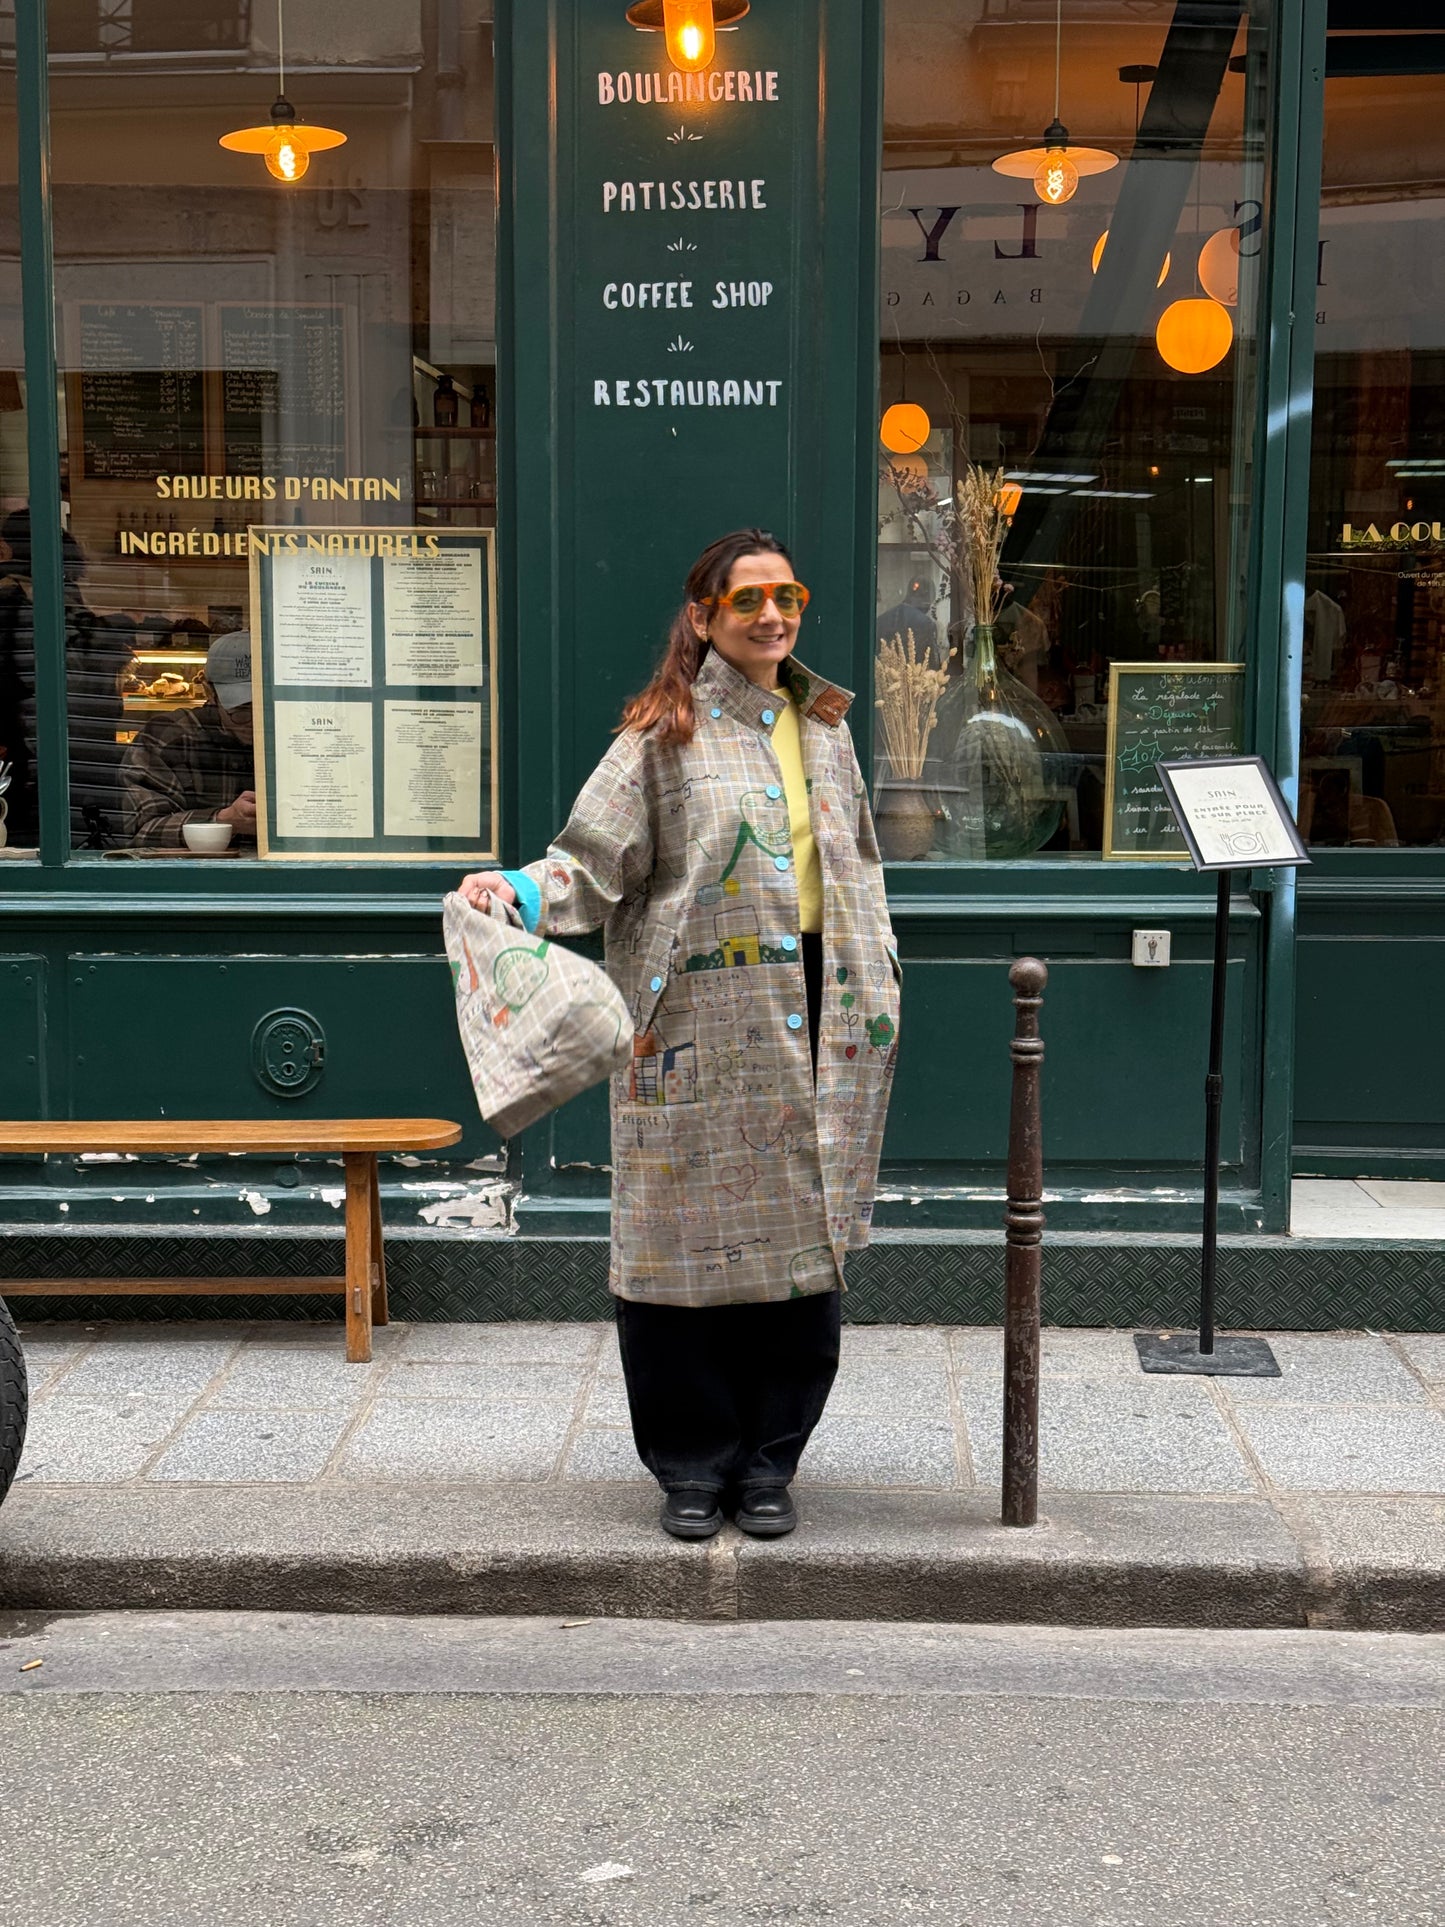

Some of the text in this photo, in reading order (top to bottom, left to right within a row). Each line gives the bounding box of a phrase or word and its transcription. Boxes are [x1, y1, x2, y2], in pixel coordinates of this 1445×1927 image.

[597, 70, 780, 106] BOULANGERIE
[602, 179, 768, 213] PATISSERIE
[602, 281, 774, 310] COFFEE SHOP
[593, 379, 783, 408] RESTAURANT
[156, 475, 401, 501] SAVEURS D'ANTAN
[119, 527, 441, 559] INGRÉDIENTS NATURELS
[1343, 522, 1383, 543] LA
[310, 566, 333, 575] SAIN
[1132, 688, 1224, 706] La régalade du
[1148, 705, 1199, 725] Déjeuner
[1183, 726, 1194, 734] de
[1177, 752, 1193, 761] de
